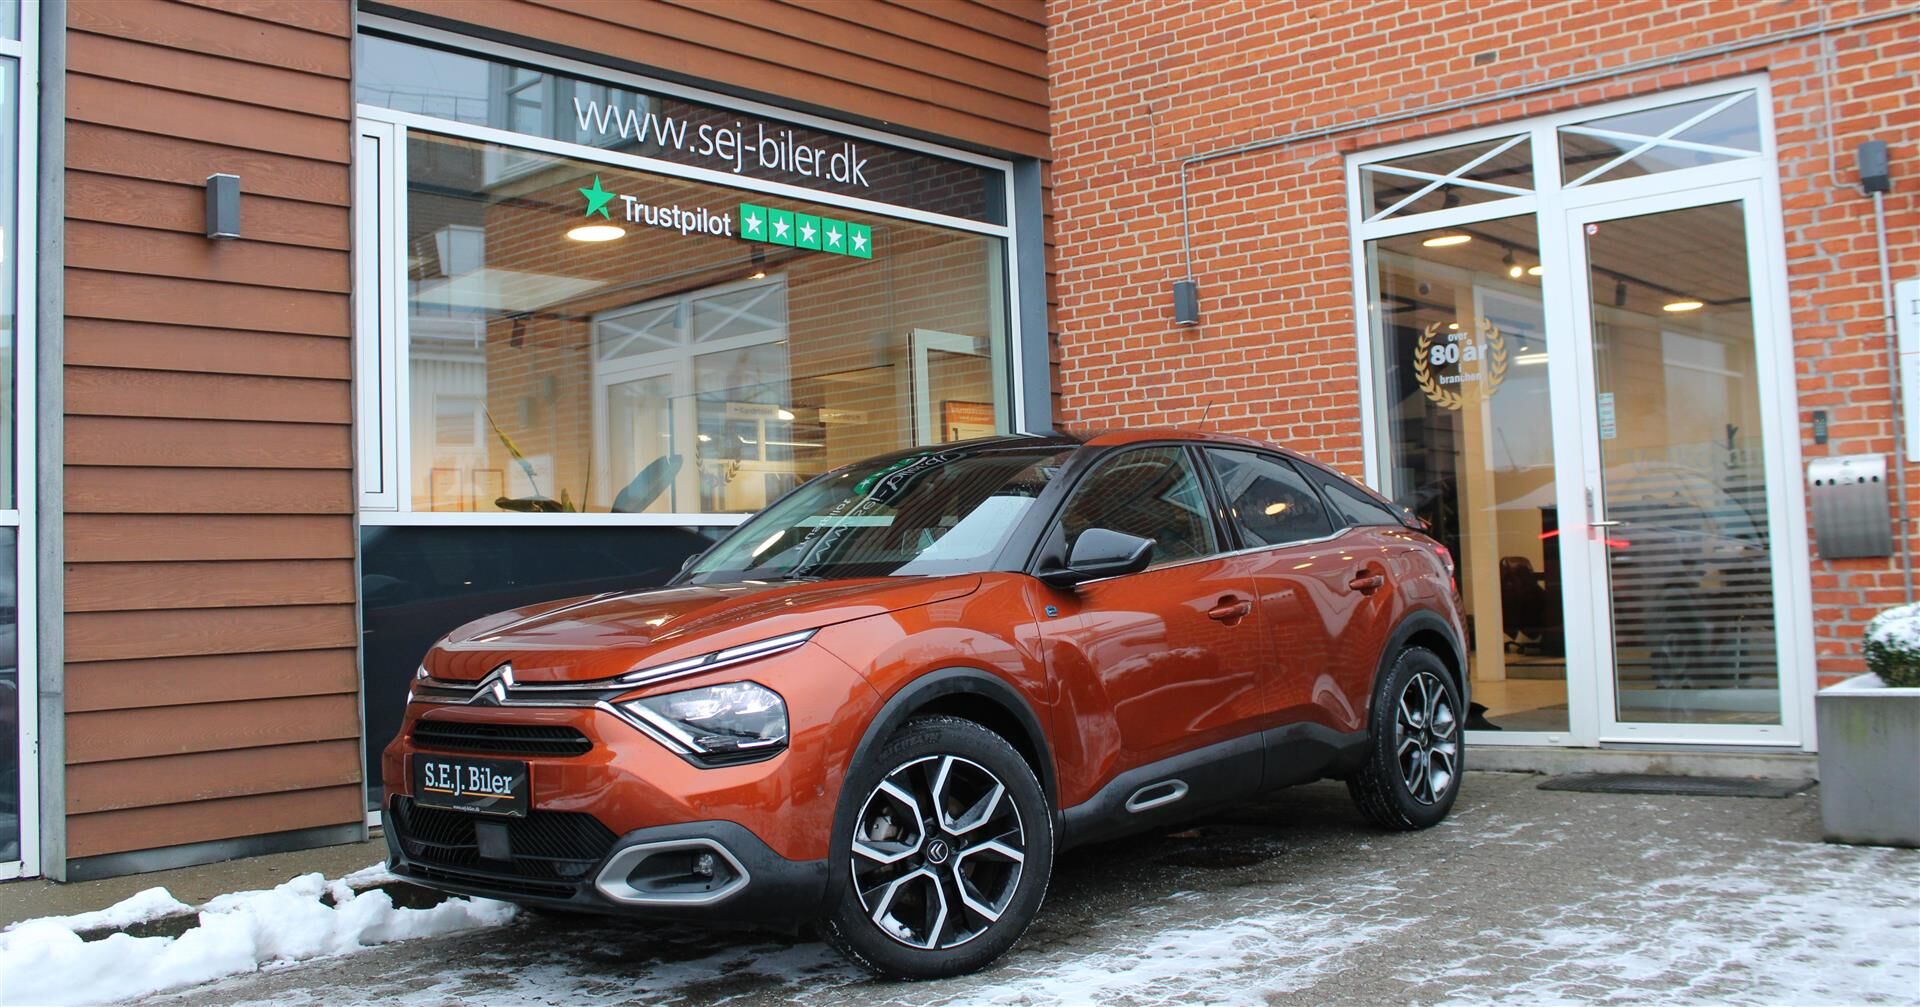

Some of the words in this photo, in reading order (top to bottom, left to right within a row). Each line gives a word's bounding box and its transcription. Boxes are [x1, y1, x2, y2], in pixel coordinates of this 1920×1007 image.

[573, 97, 869, 187] www.sej-biler.dk
[620, 194, 732, 237] Trustpilot
[1447, 332, 1468, 342] over
[1430, 343, 1459, 366] 80
[1462, 339, 1488, 362] år
[1440, 374, 1482, 384] branchen
[425, 762, 465, 796] S.E.J.
[468, 766, 513, 794] Biler
